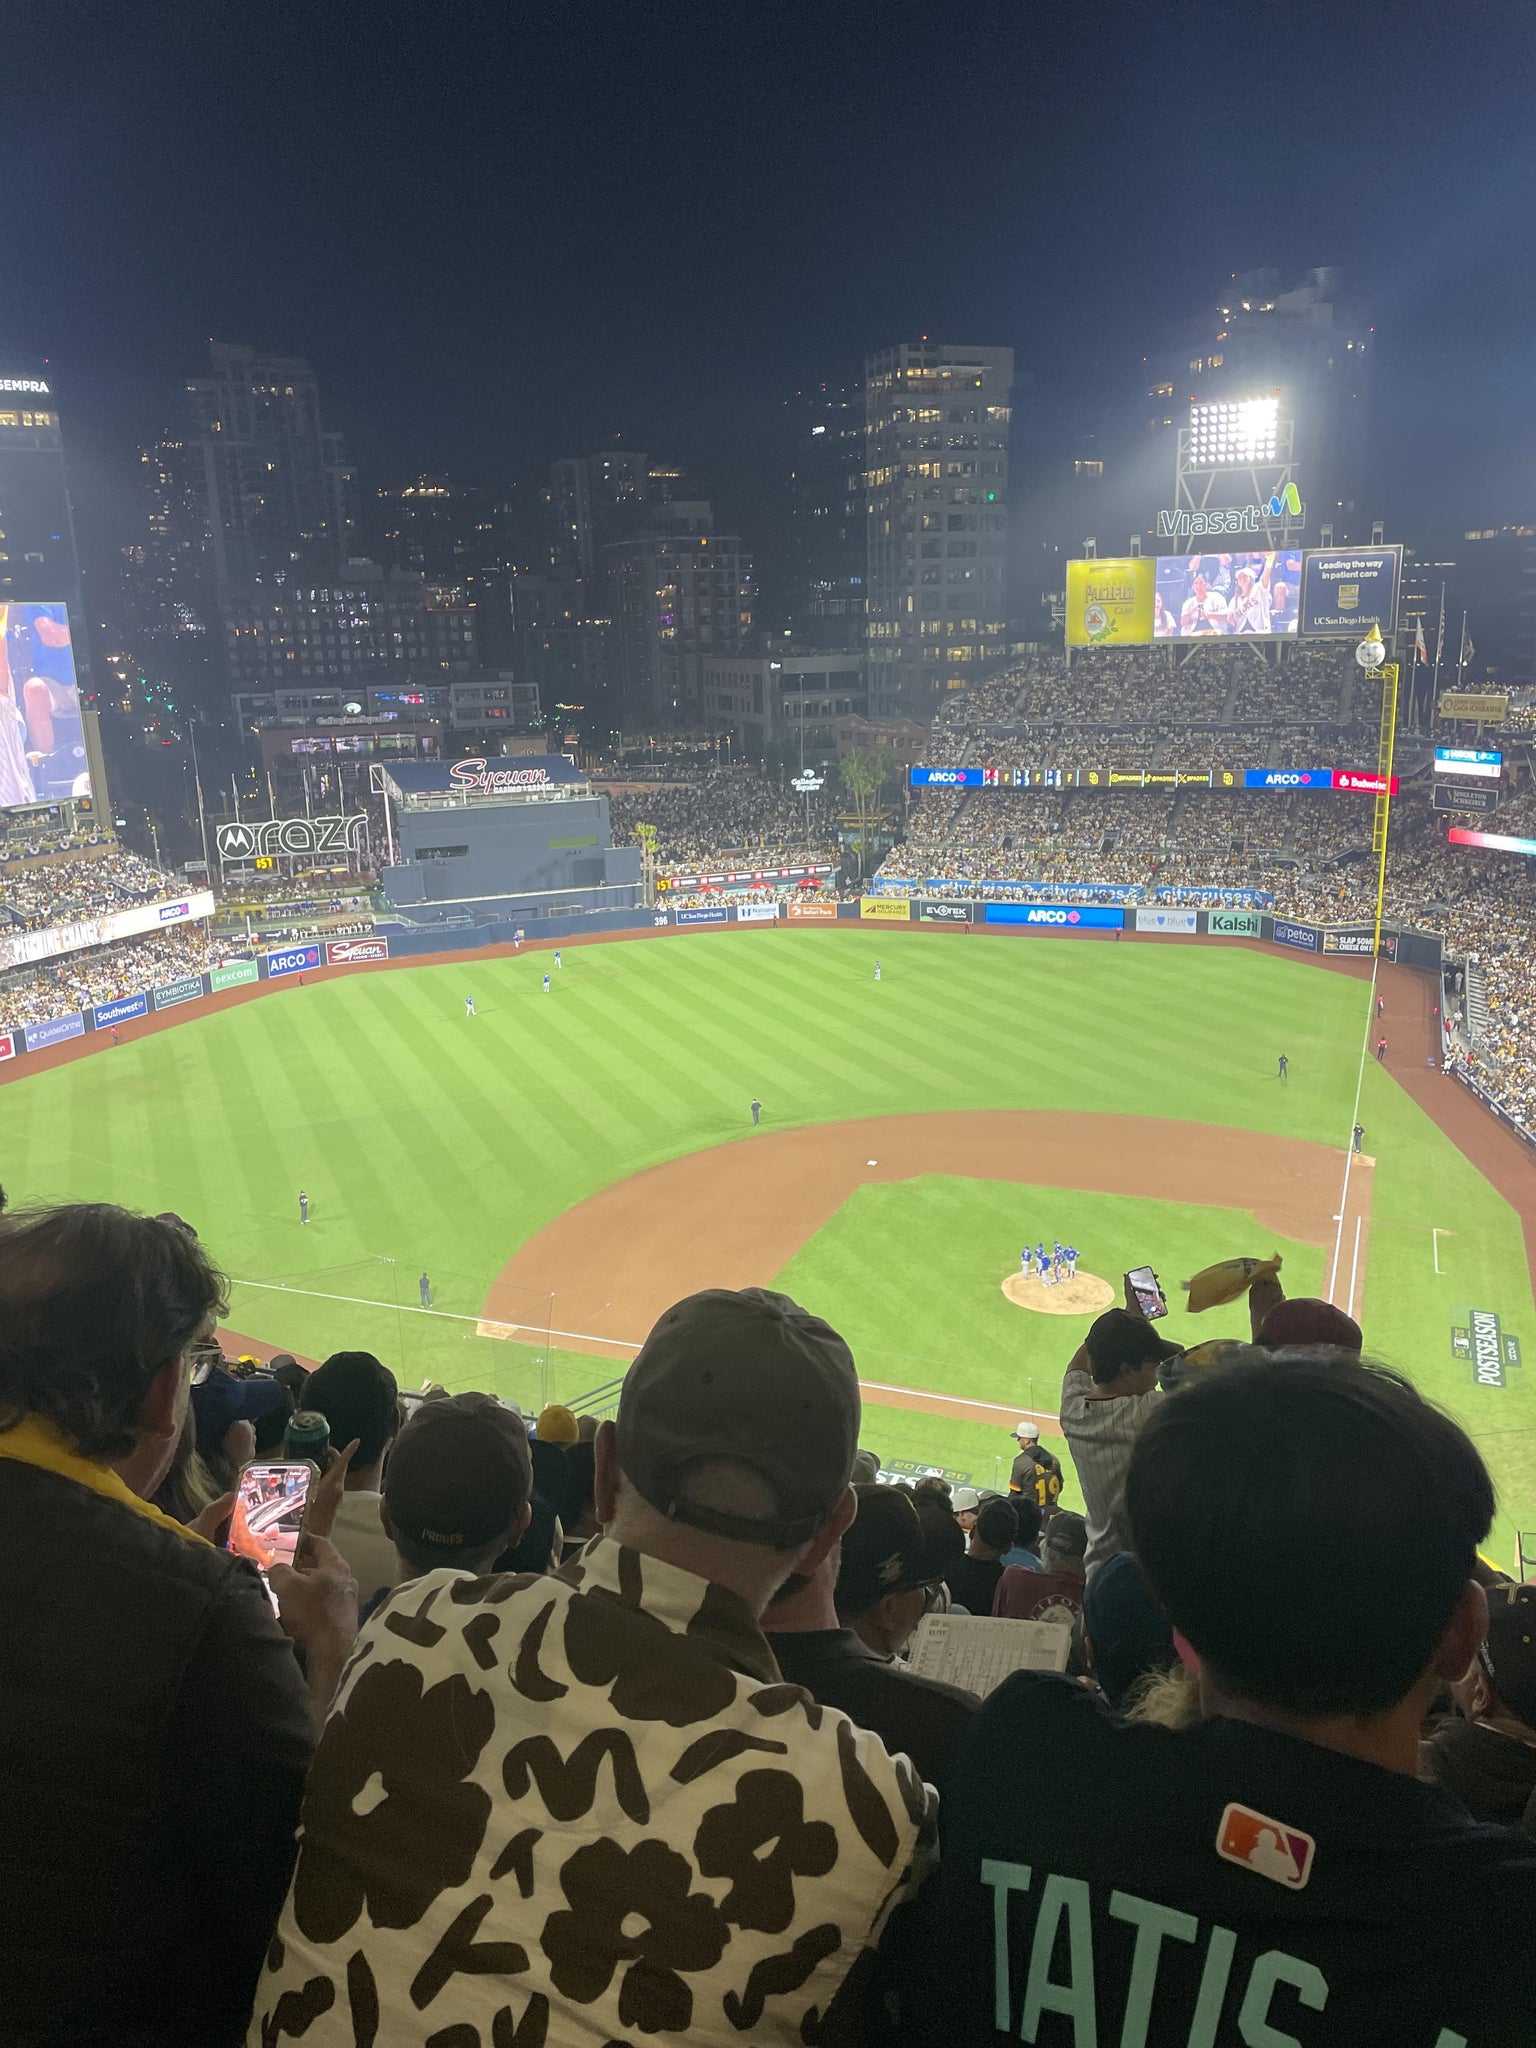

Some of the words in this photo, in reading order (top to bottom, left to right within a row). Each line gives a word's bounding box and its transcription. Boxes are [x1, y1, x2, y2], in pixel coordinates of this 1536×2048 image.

[0, 379, 49, 393] SEMPRA
[1161, 505, 1259, 536] Viasat
[1319, 561, 1351, 570] Leading
[1366, 561, 1383, 569] way
[1331, 571, 1358, 580] patient
[1314, 617, 1325, 625] UC
[1339, 616, 1357, 625] Diego
[1358, 616, 1380, 624] Health
[450, 758, 550, 795] Sycuan
[928, 773, 956, 782] ARCO
[1266, 774, 1299, 784] ARCO
[1351, 777, 1387, 790] Budweise
[258, 814, 368, 857] razr
[161, 906, 181, 919] ARCO
[927, 905, 966, 916] EVOTEK
[1028, 910, 1067, 922] ARCO
[654, 916, 668, 926] 396
[1138, 915, 1156, 923] blue
[1213, 916, 1258, 932] Kalshi
[1287, 928, 1314, 942] petco
[1339, 936, 1356, 944] SLAP
[332, 943, 382, 960] Sycuan
[270, 953, 305, 971] ARCO
[156, 980, 200, 1000] CYMBIOTIKA
[97, 1004, 139, 1022] Southwest
[39, 1020, 81, 1040] QuidelOrtho
[1474, 1311, 1501, 1386] POSTSEASON
[894, 1461, 914, 1470] 20
[1035, 1475, 1060, 1506] 19
[980, 1858, 1329, 2048] TATIS
